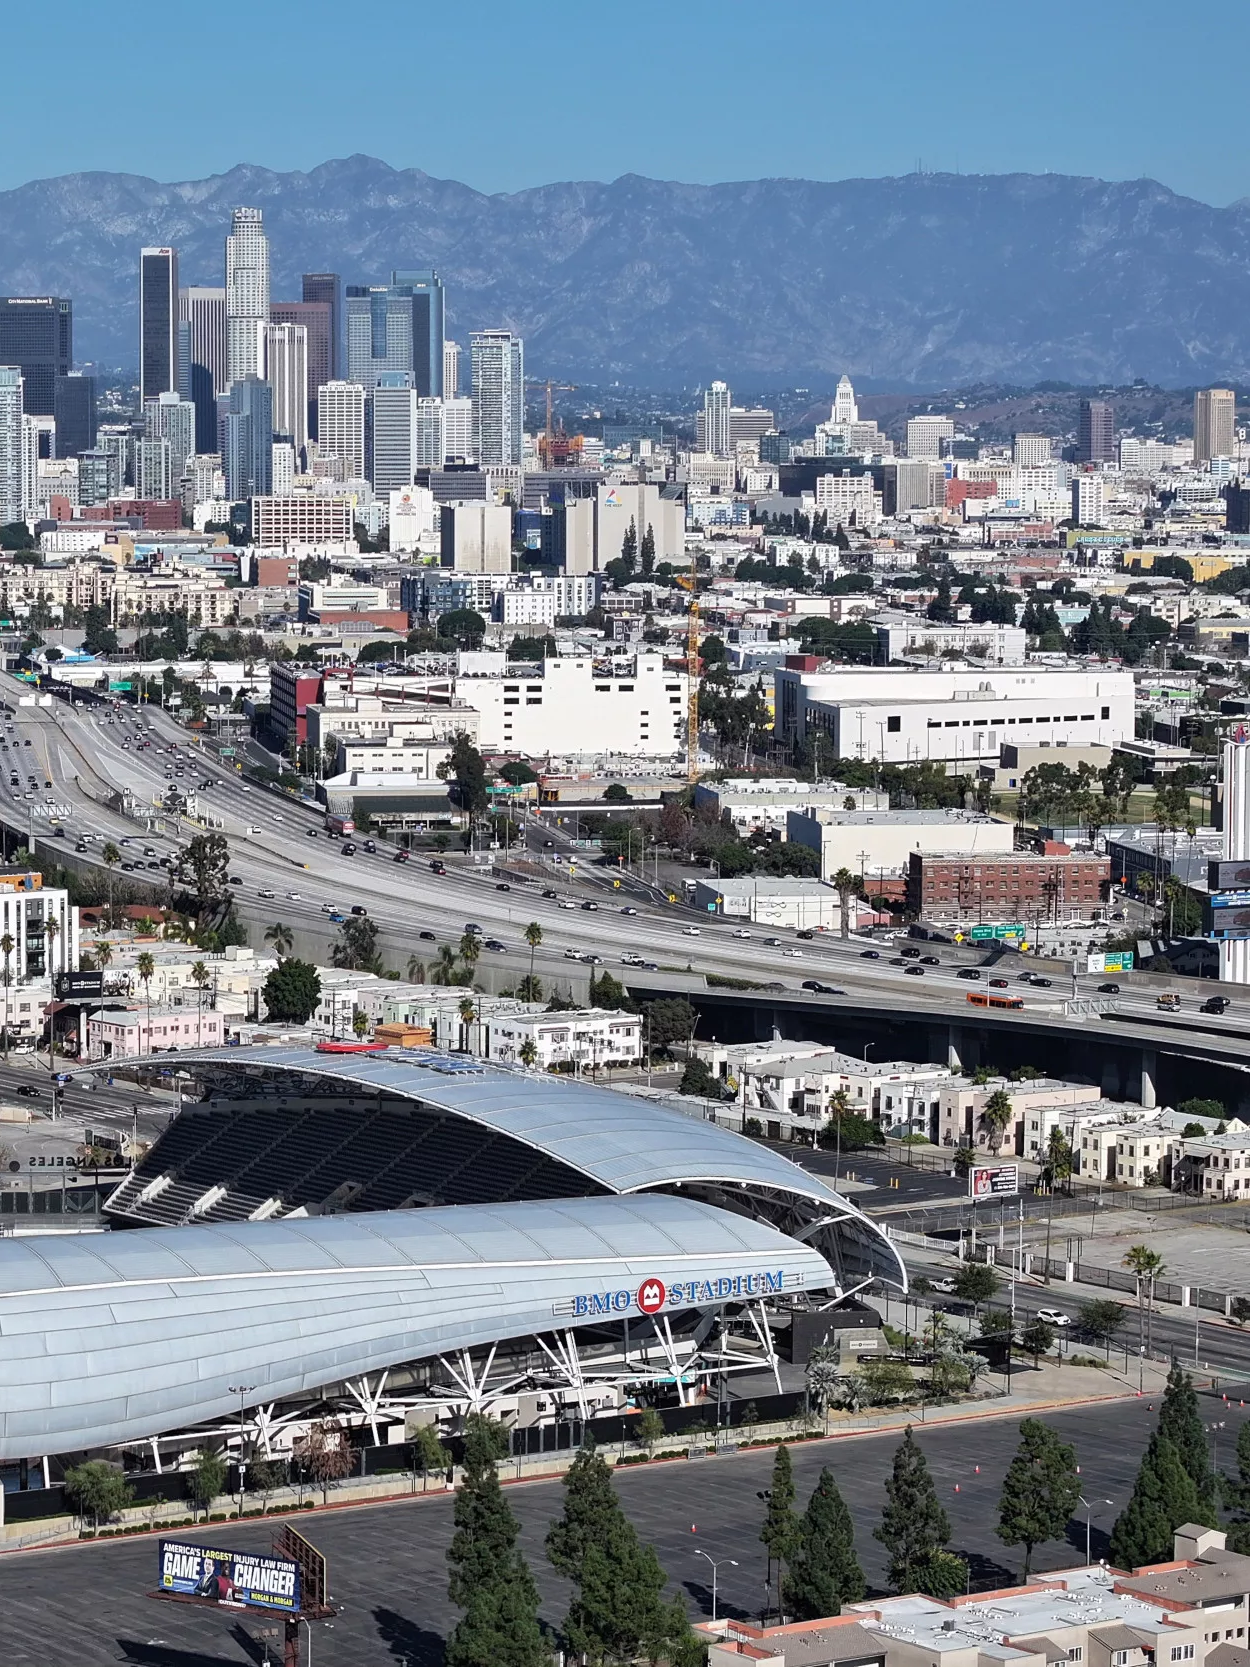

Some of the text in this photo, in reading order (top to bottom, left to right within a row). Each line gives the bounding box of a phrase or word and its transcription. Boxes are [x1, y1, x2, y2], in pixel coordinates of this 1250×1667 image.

[574, 1270, 784, 1315] BMO STADIUM
[163, 1543, 295, 1573] AMERICA'S LARGEST INJURY LAW FIRM
[163, 1552, 295, 1596] GAME CHANGER
[251, 1592, 270, 1602] MORGAN
[270, 1595, 274, 1603] &
[274, 1596, 293, 1607] MORGAN
